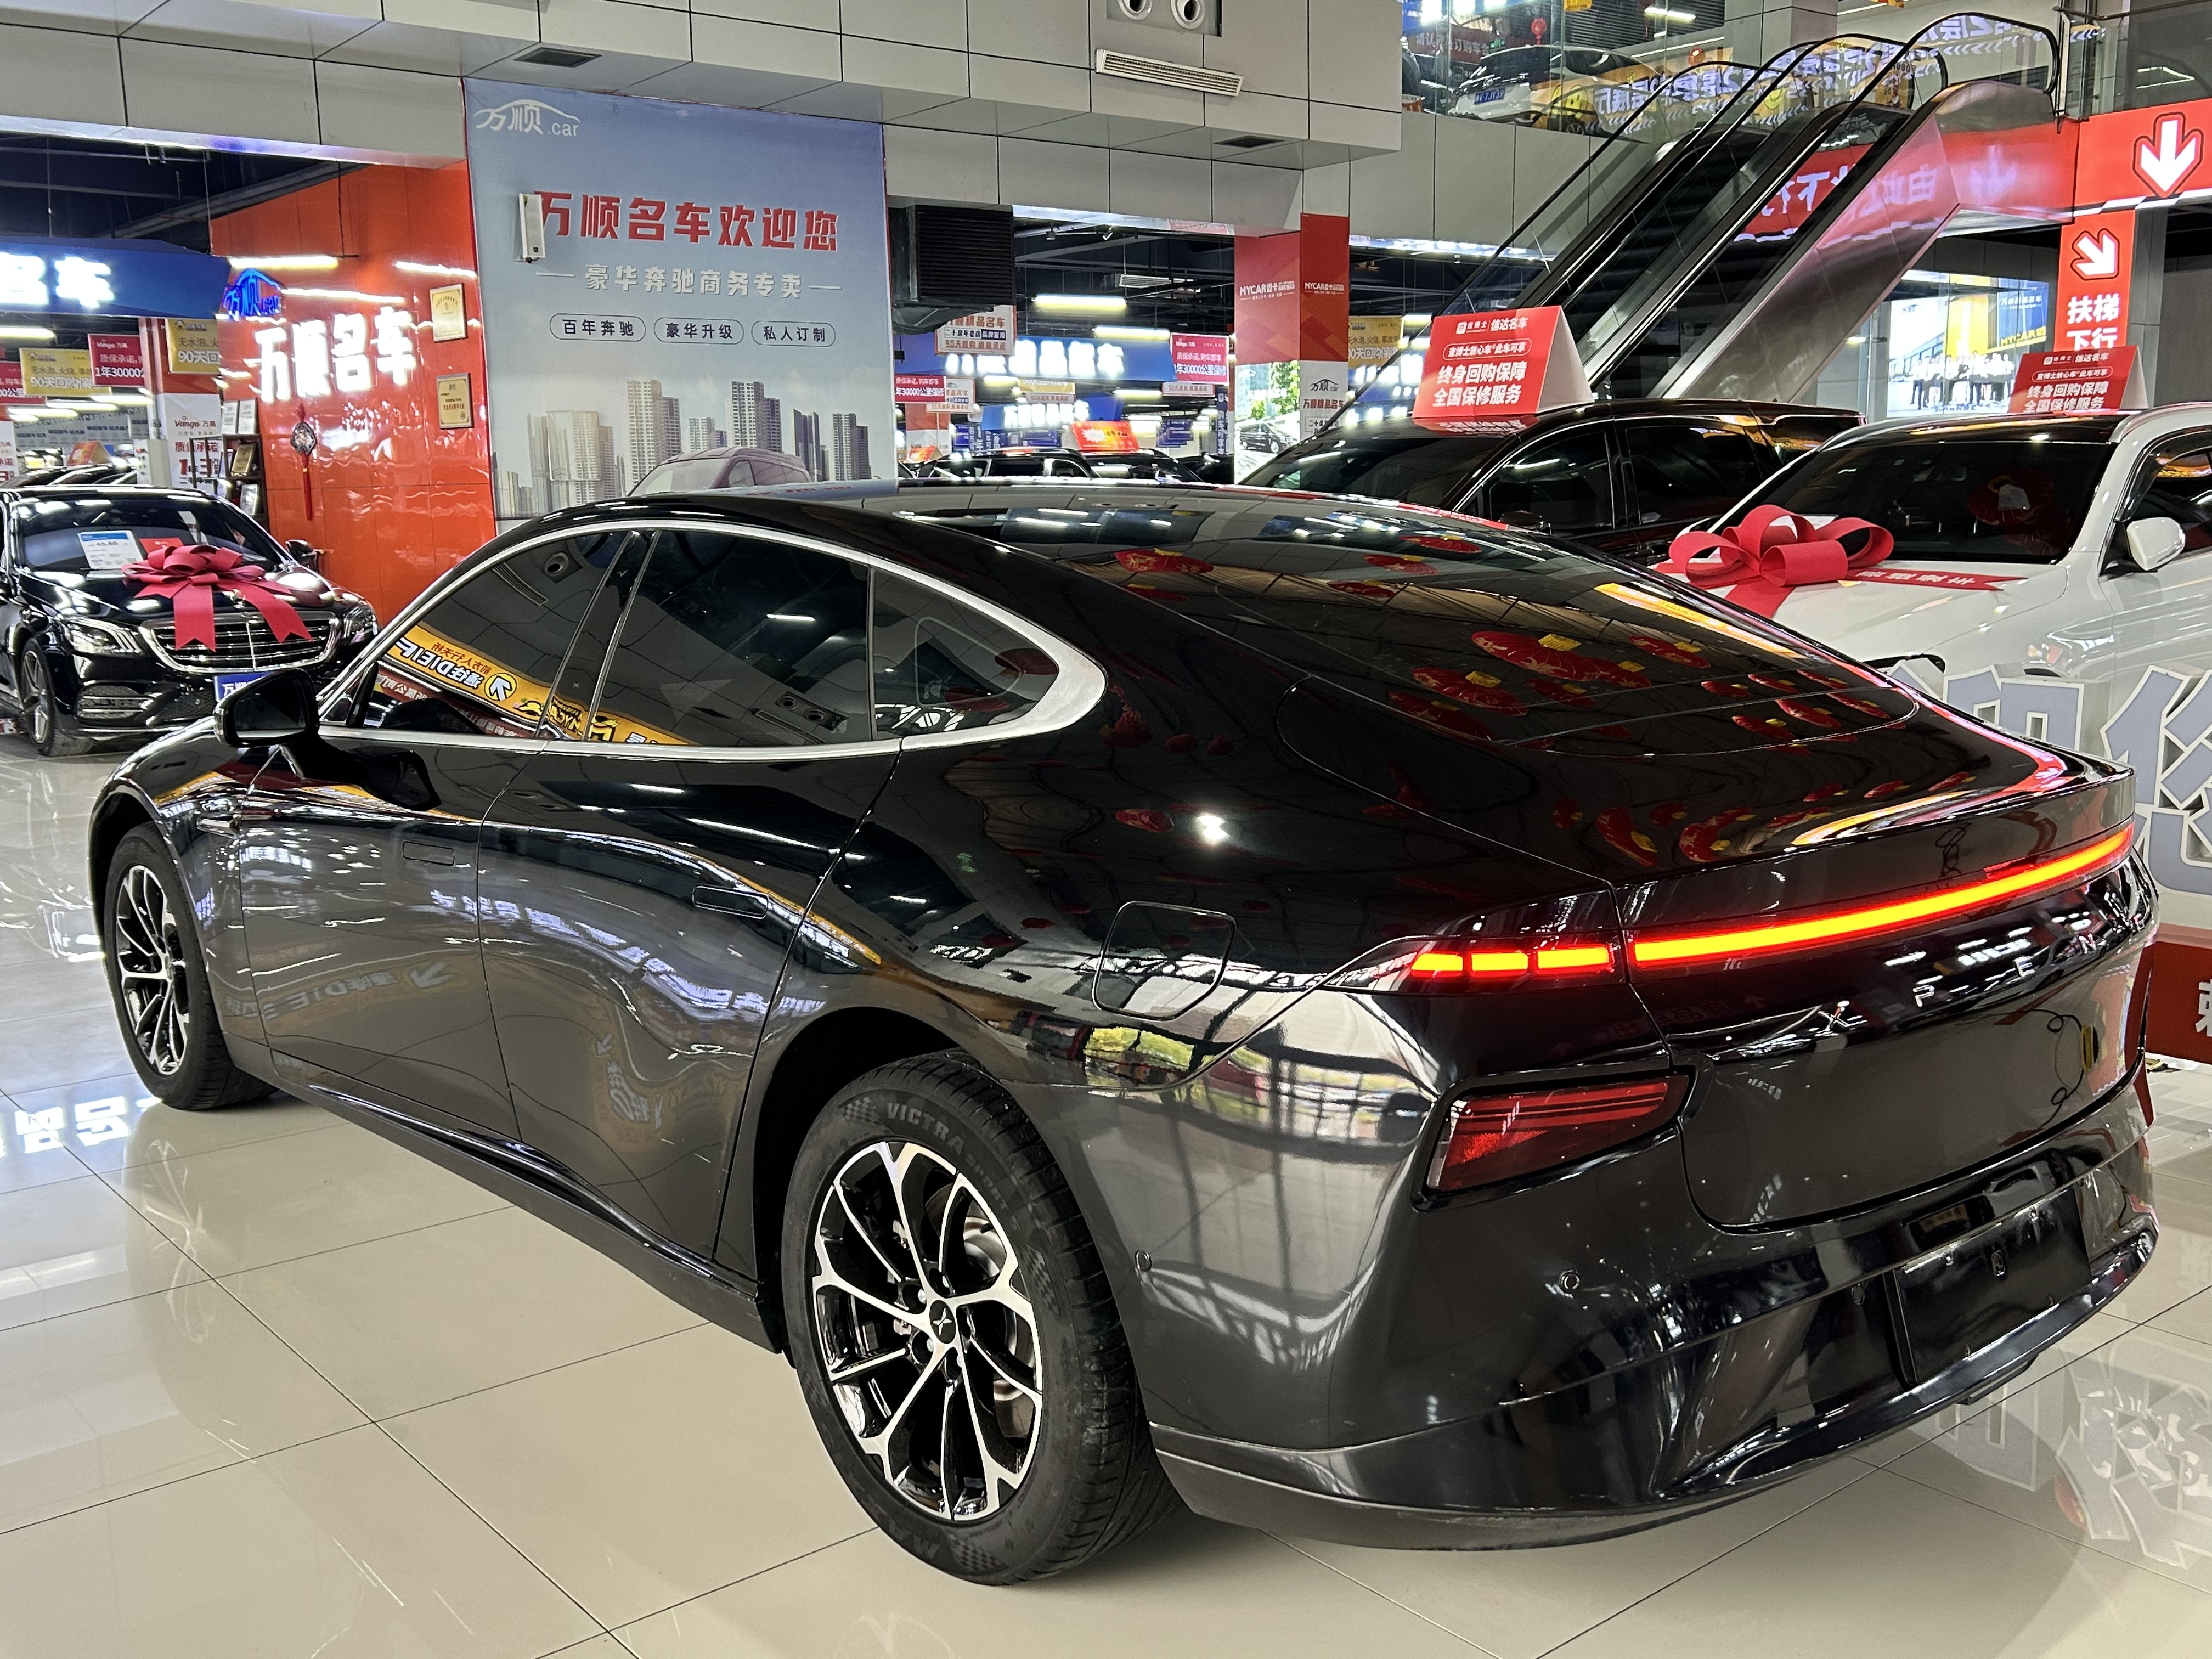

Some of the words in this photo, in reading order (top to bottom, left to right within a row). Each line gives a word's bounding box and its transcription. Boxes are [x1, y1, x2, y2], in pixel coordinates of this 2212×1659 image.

[534, 190, 839, 251] 万顺名车欢迎您
[585, 264, 802, 299] 豪华奔驰商务专卖
[2067, 293, 2120, 324] 扶梯
[562, 319, 634, 337] 百年奔驰
[665, 322, 734, 340] 豪华升级
[763, 326, 826, 342] 私人订制
[1491, 317, 1529, 332] 信达名车
[2067, 327, 2118, 351] 下行
[1436, 360, 1527, 385] 终身回购保障
[1432, 384, 1522, 407] 全国保修服务
[2026, 380, 2109, 399] 终身回购保障
[2023, 396, 2104, 413] 全国保修服务
[174, 419, 200, 429] Vango
[887, 1102, 964, 1154] VICTRA
